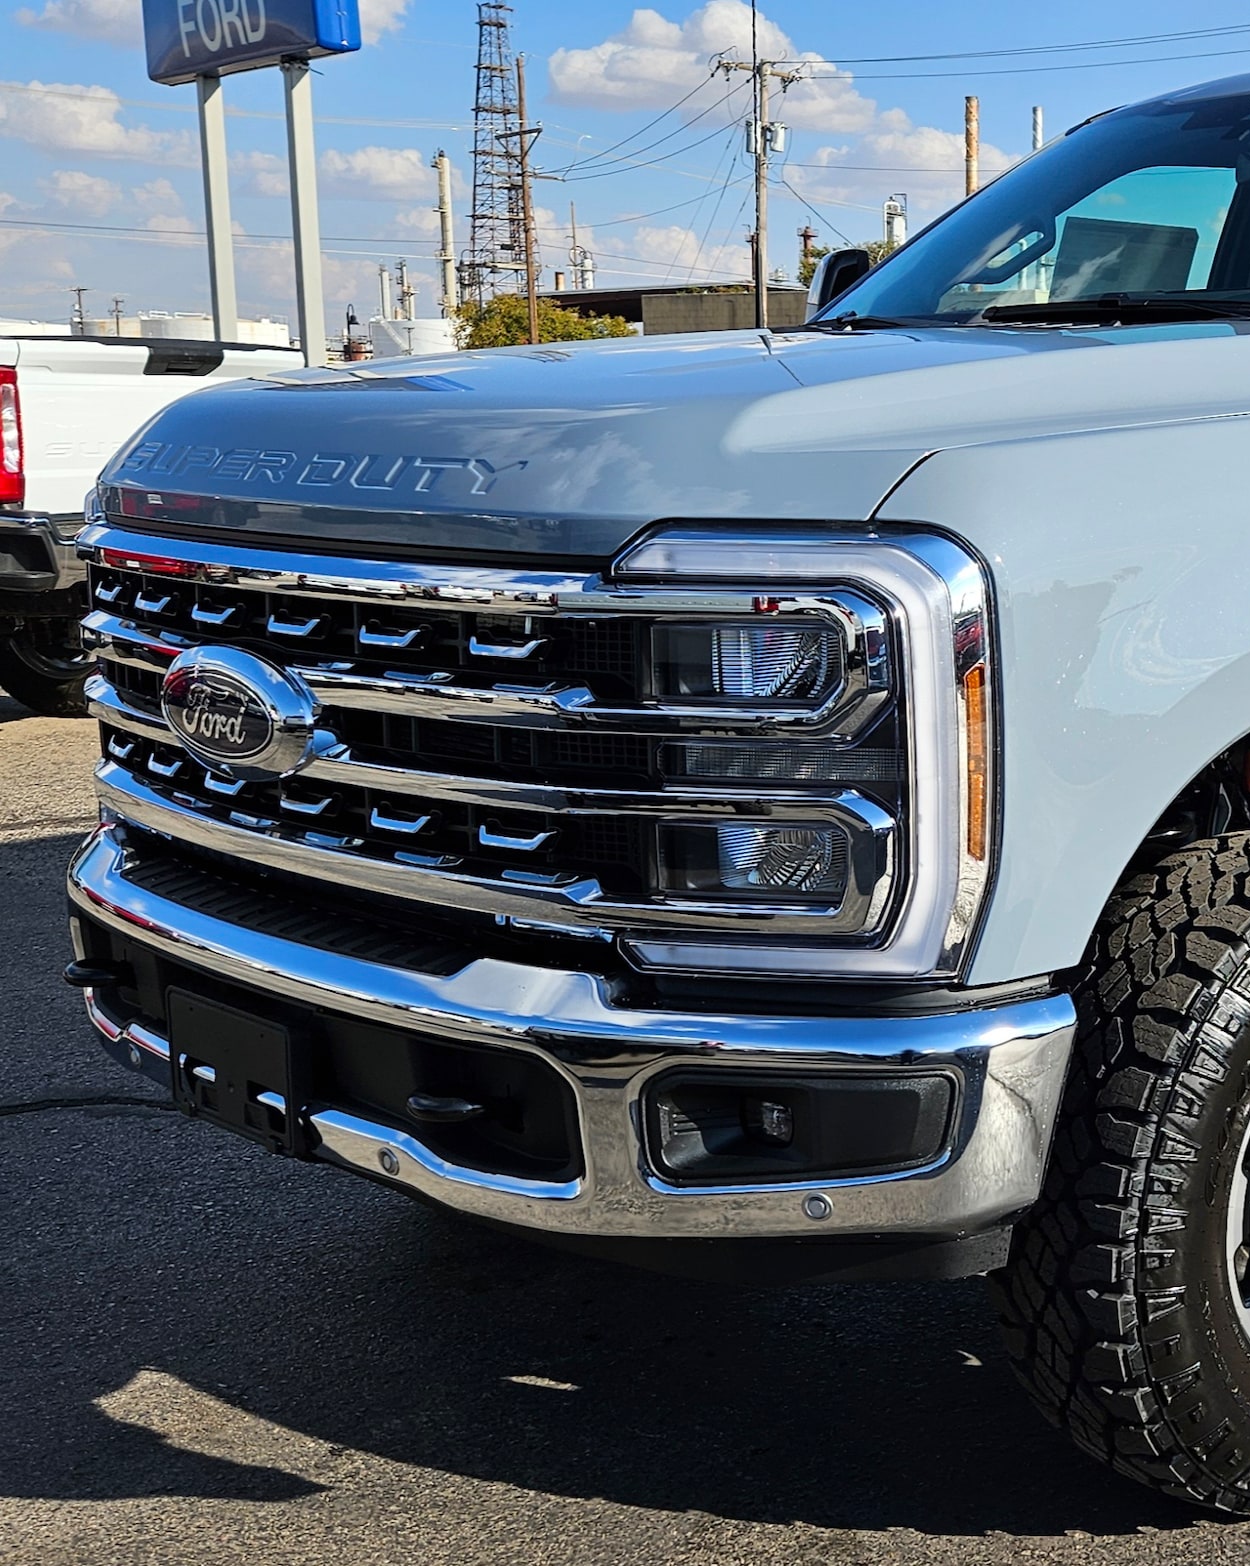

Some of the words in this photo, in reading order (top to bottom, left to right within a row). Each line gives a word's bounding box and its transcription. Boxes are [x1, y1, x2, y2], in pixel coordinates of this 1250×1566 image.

[177, 0, 267, 58] FORD
[123, 441, 298, 484] SUPER
[297, 452, 529, 496] DUTY
[182, 682, 248, 745] Ford
